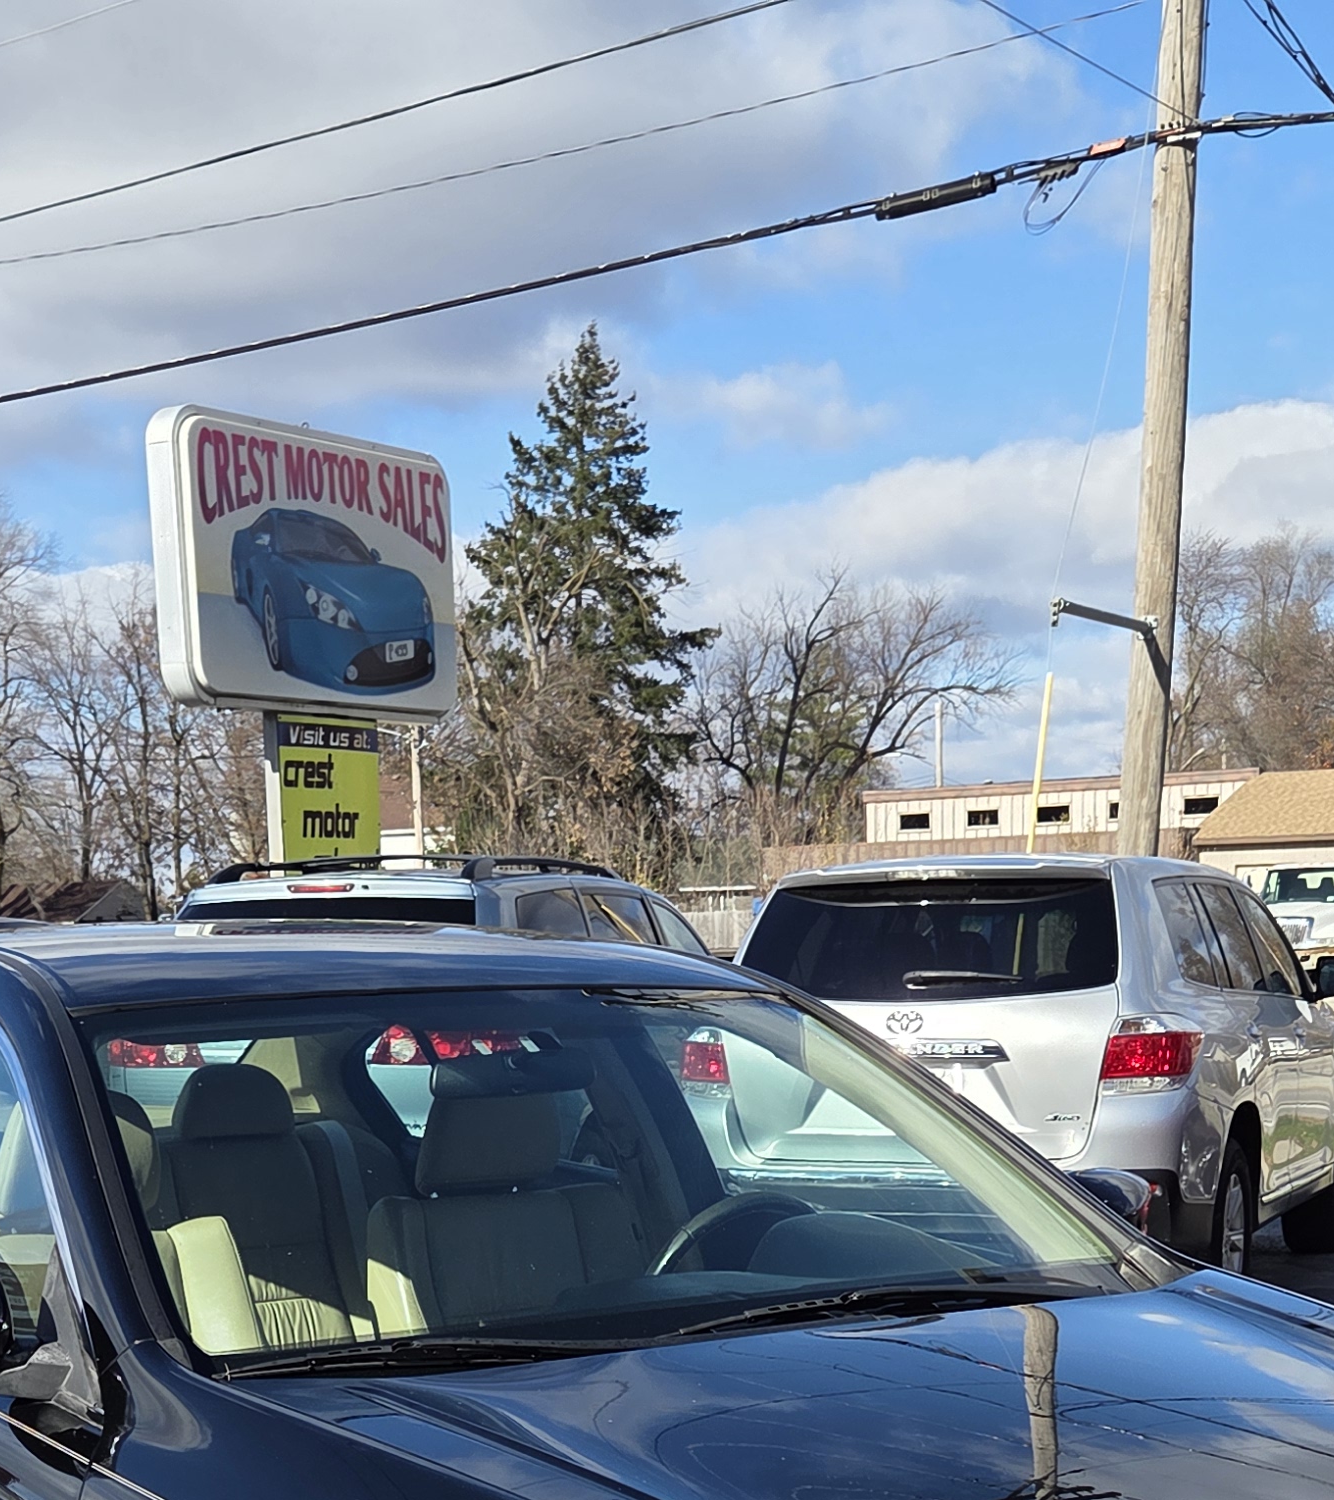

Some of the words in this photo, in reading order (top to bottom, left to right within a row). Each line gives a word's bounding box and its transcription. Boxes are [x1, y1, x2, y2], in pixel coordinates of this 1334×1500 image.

[197, 426, 279, 525] CREST
[283, 443, 374, 516] MOTOR
[378, 462, 447, 565] SALES
[289, 725, 324, 746] Visit
[329, 730, 350, 748] us
[284, 753, 334, 789] crest
[302, 803, 359, 839] motor
